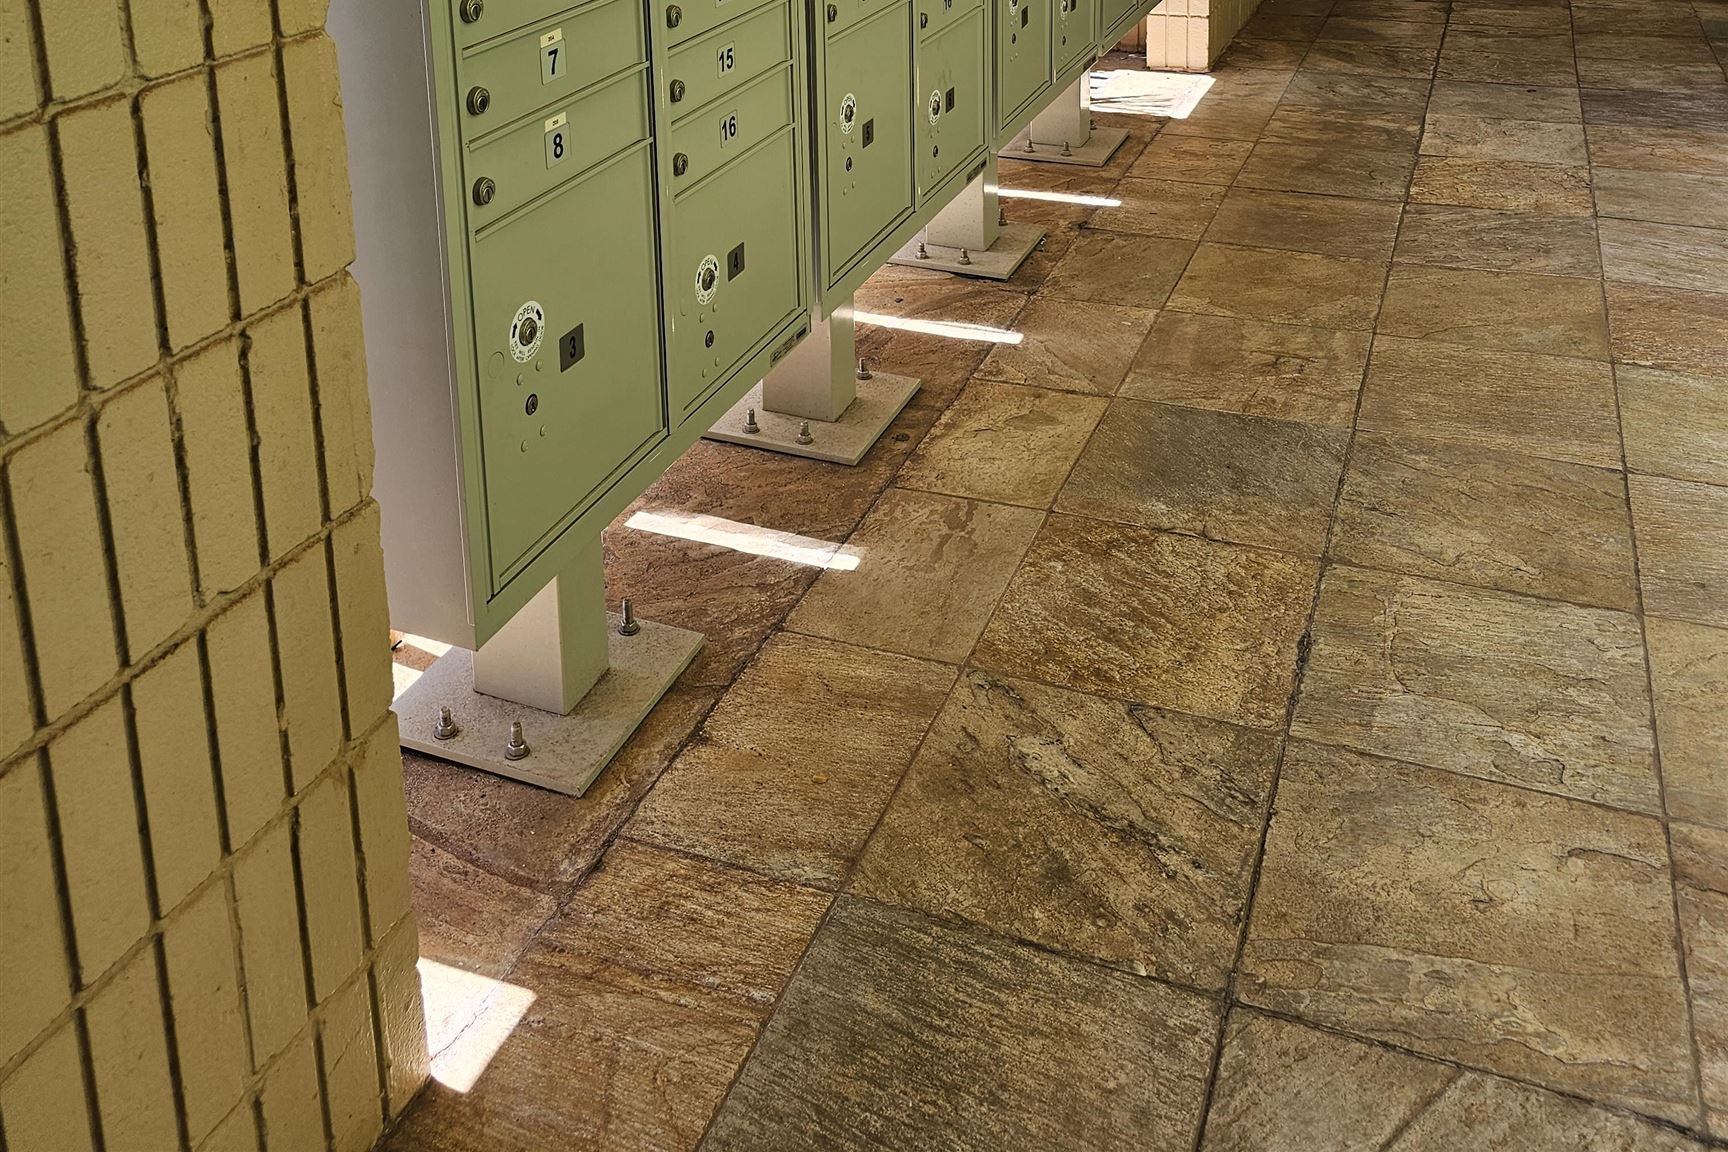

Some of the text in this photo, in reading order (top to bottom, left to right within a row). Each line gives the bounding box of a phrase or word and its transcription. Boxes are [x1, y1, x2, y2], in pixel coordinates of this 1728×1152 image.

[547, 48, 559, 75] 7
[718, 47, 734, 72] 15
[721, 115, 737, 141] 16
[552, 132, 564, 159] 8
[733, 252, 739, 271] 4
[517, 305, 536, 322] OPEN
[569, 335, 577, 359] 3
